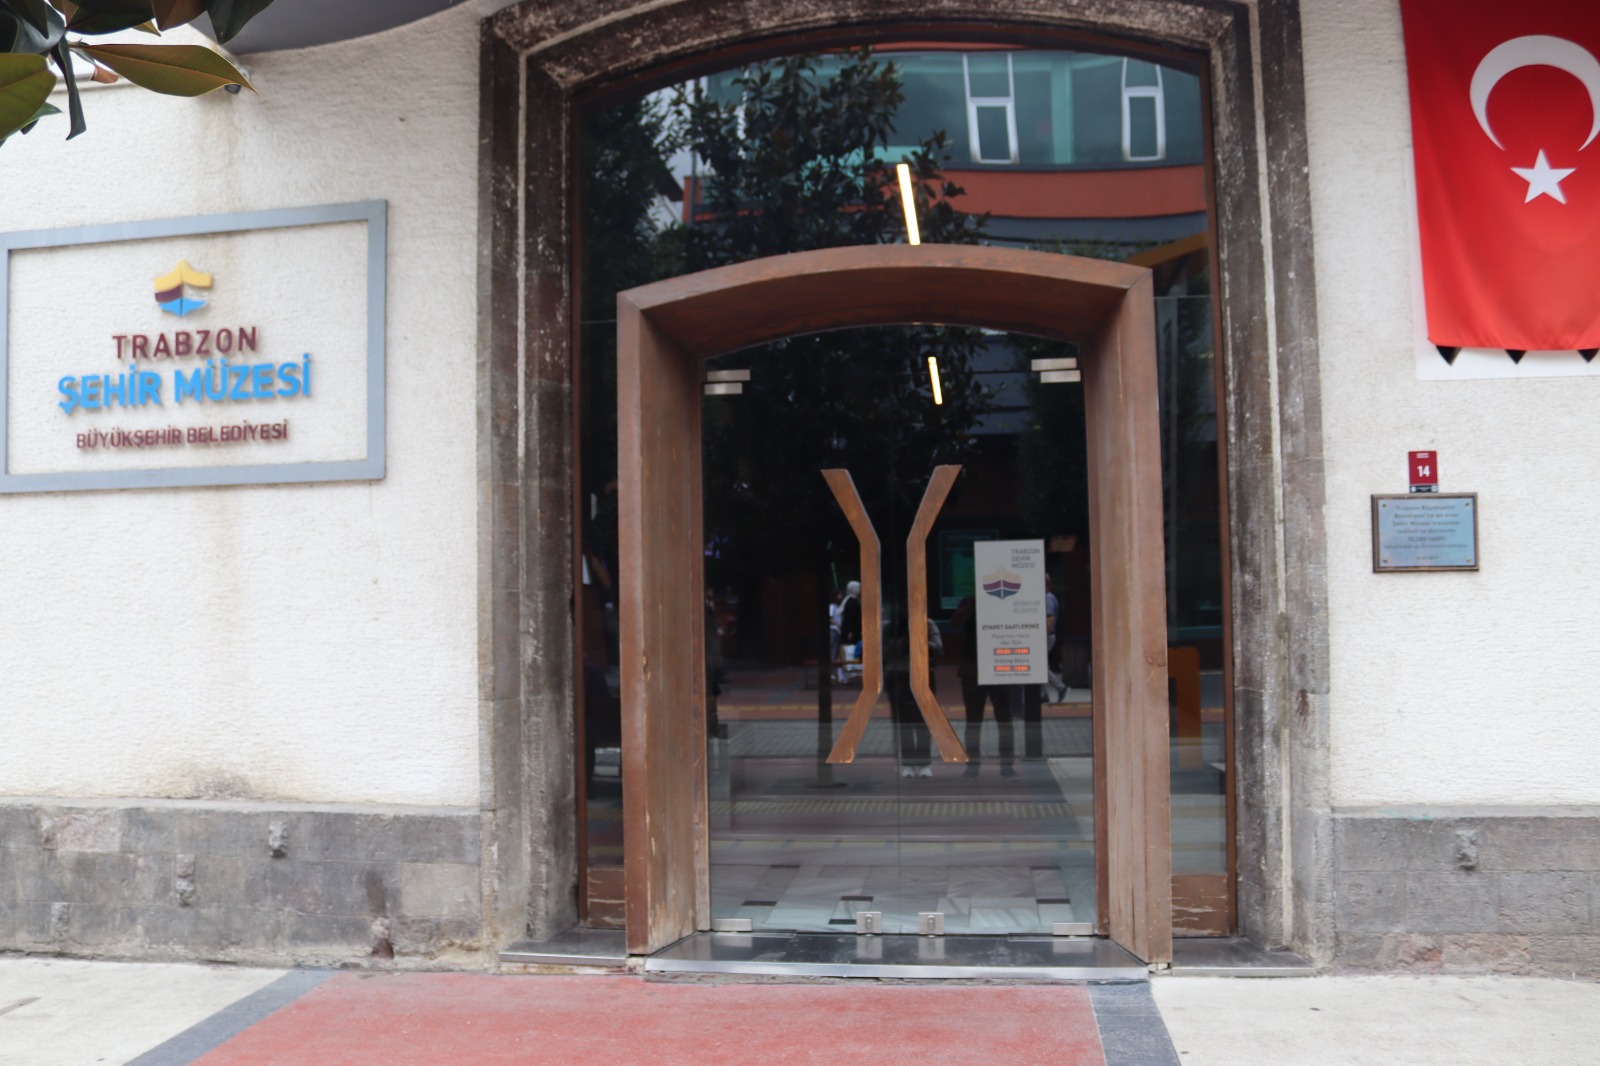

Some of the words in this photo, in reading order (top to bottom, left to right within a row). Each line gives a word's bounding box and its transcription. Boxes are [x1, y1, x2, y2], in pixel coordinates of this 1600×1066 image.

[112, 326, 258, 360] TRABZON
[57, 363, 162, 415] ŞEHİR
[174, 353, 312, 403] MÜZESİ
[76, 424, 182, 449] BÜYÜKŞEHİR
[187, 418, 288, 444] BELEDİYESİ
[1417, 465, 1430, 477] 14
